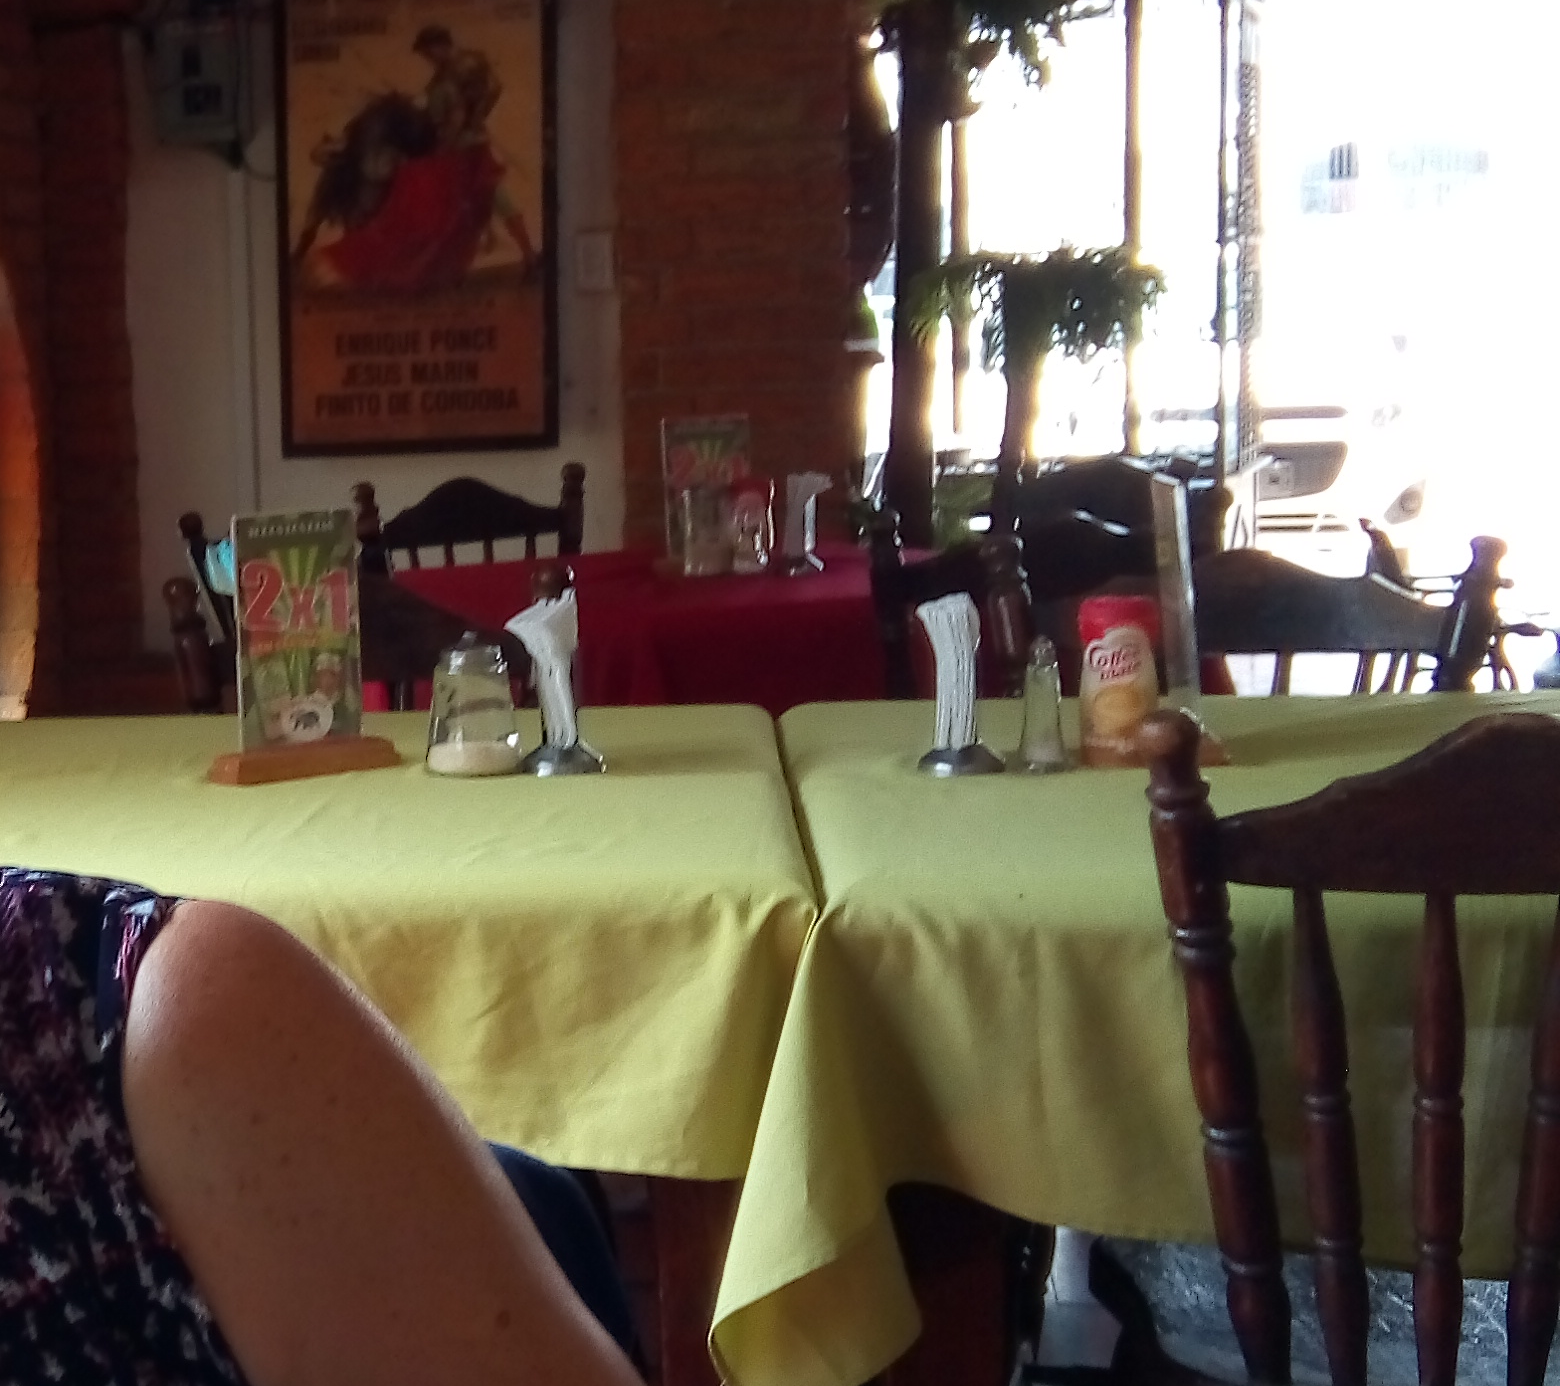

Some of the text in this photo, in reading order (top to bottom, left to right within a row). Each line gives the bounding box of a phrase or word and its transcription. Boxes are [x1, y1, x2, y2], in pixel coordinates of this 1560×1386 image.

[335, 326, 498, 357] ENRIQUE PONCE
[342, 363, 401, 387] JESUS
[388, 391, 413, 415] DE
[420, 388, 520, 414] CORDOBA
[241, 561, 350, 634] 2x1
